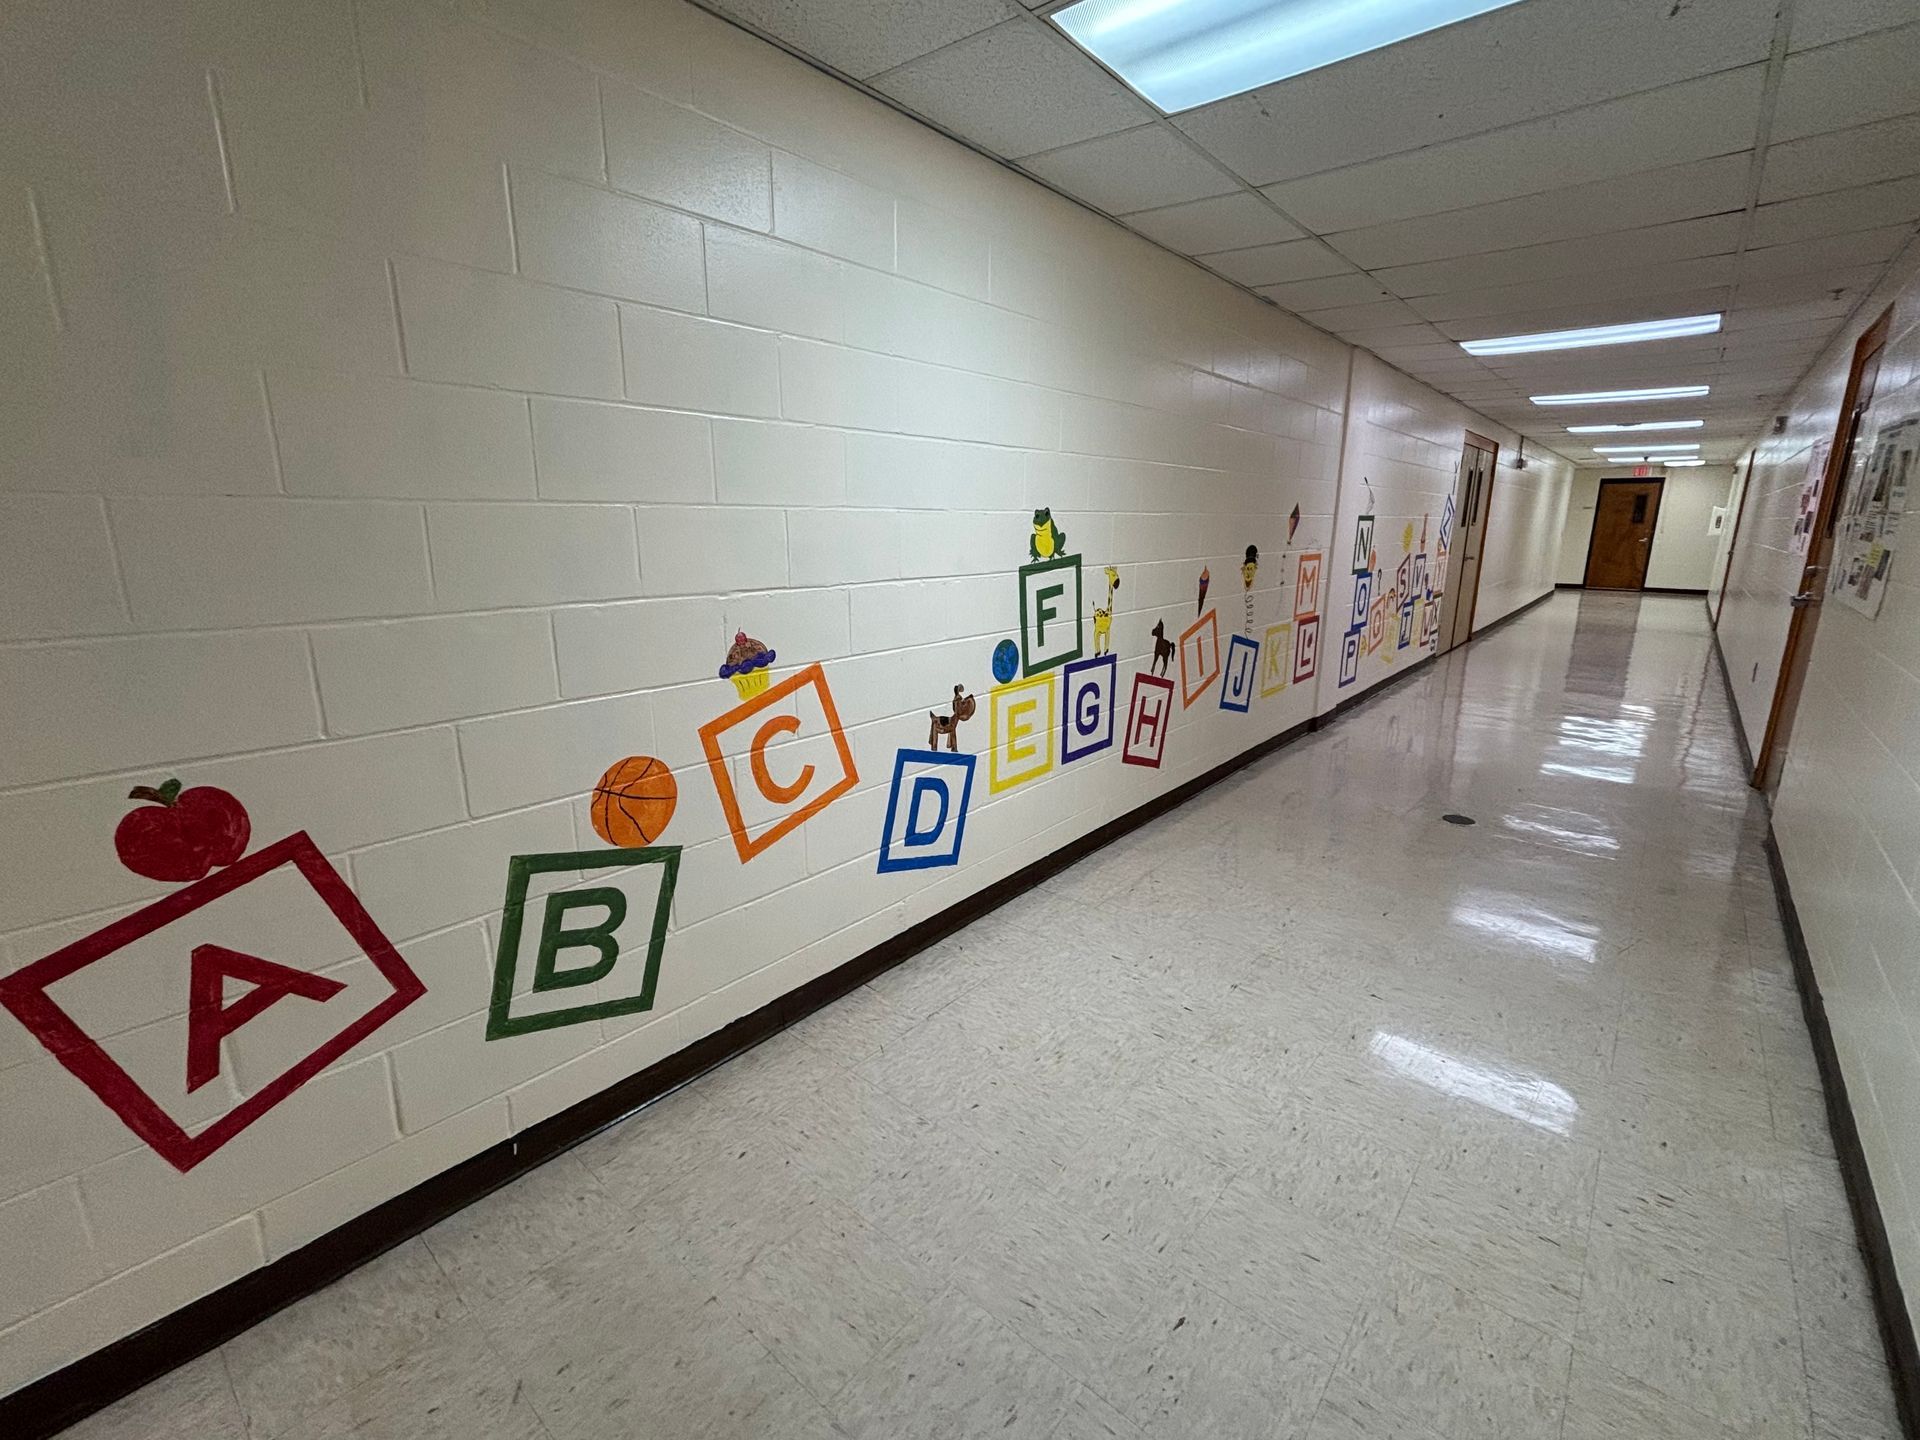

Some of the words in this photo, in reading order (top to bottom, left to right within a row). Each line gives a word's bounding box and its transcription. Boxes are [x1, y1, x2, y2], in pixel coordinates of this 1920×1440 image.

[1357, 527, 1370, 562] N
[1300, 565, 1316, 606] M
[1357, 583, 1367, 616] O
[1399, 568, 1406, 598] S
[1036, 583, 1063, 647] F
[1373, 612, 1382, 639] Q
[1197, 636, 1204, 677] I
[1268, 636, 1282, 680] K
[1301, 632, 1311, 668] L
[1345, 639, 1355, 677] P
[1233, 651, 1248, 697] J
[1007, 698, 1037, 763] E
[1075, 682, 1101, 736] G
[1134, 696, 1162, 748] H
[750, 715, 815, 803] C
[904, 777, 949, 847] D
[532, 886, 627, 993] B
[186, 943, 348, 1094] A
